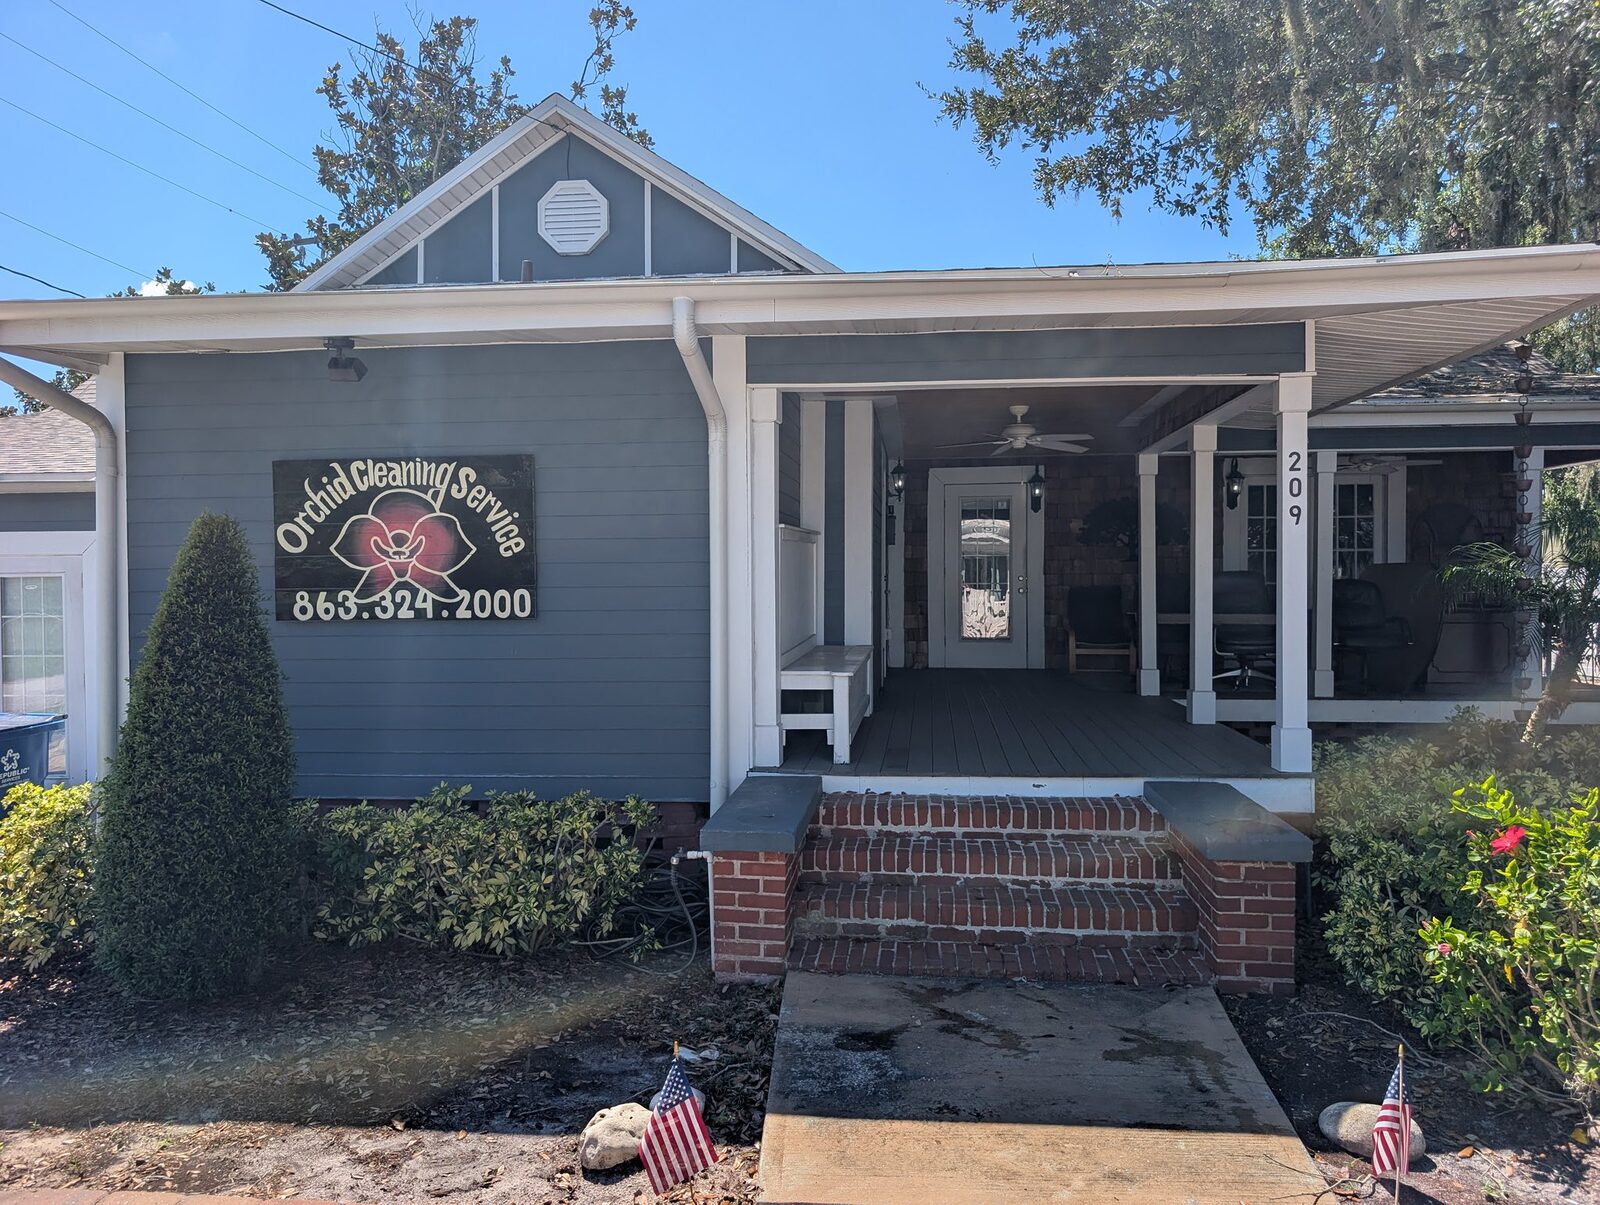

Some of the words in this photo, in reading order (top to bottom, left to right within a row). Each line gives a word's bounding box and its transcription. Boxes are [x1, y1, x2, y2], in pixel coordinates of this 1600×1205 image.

[276, 462, 357, 554] Orchid
[350, 457, 457, 512] Cleaning
[450, 466, 526, 558] Service
[1288, 451, 1302, 526] 209
[293, 588, 532, 621] 863.324.2000
[0, 767, 28, 779] EPUBLIC
